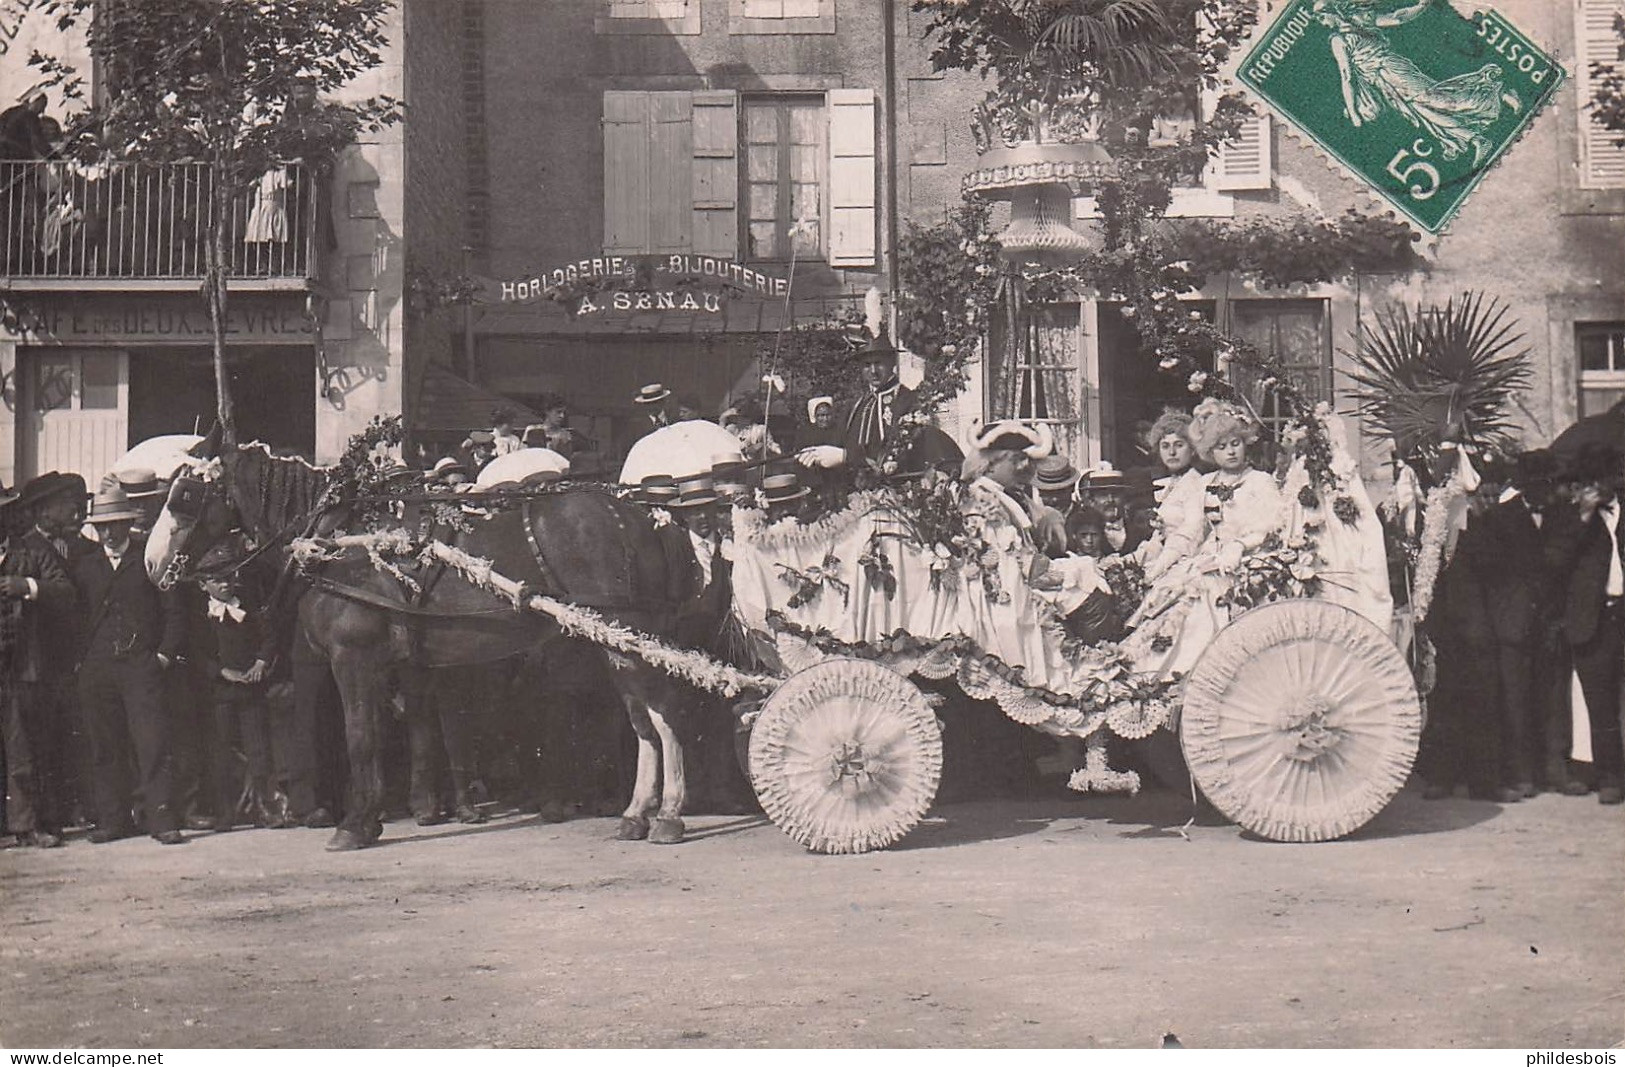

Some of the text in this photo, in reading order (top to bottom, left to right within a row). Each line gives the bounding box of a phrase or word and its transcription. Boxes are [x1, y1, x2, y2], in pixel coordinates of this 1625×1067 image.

[1249, 6, 1315, 84] REPUBLIQUE
[1476, 19, 1548, 85] POSTES
[502, 255, 788, 301] HORLOGERIE BIJOUTERIE
[613, 291, 720, 312] SENAU
